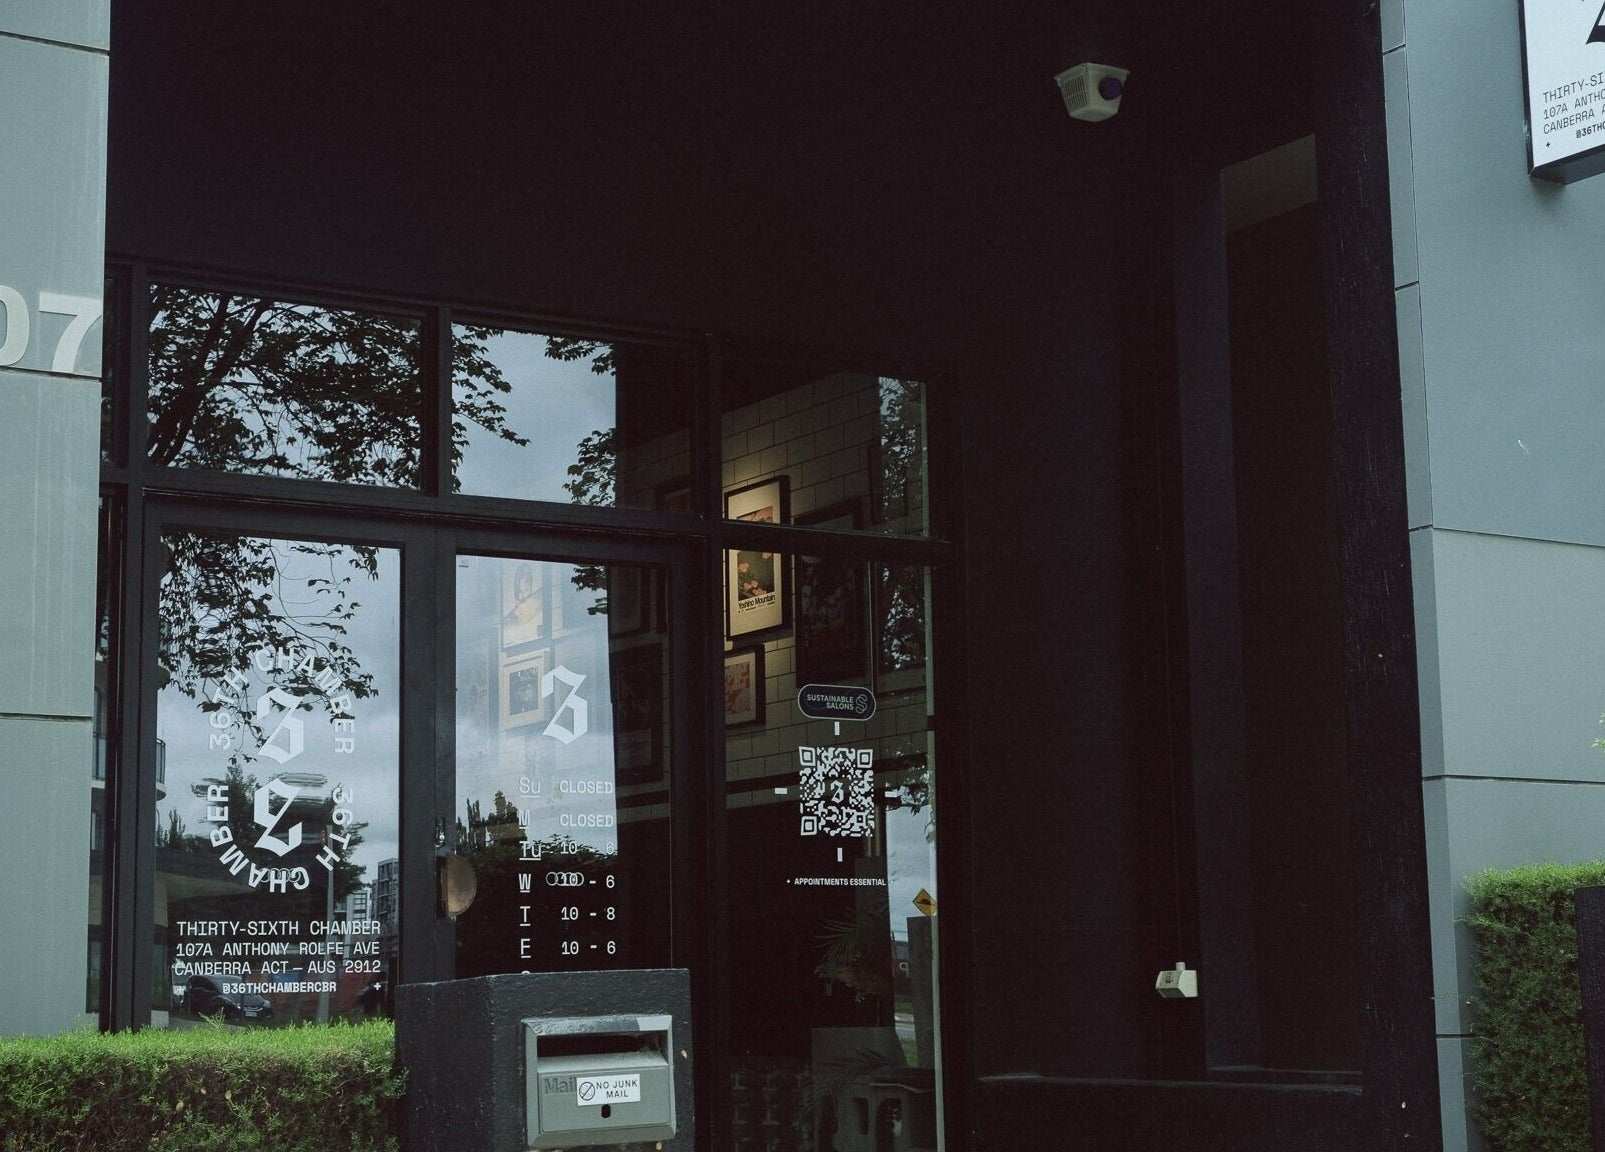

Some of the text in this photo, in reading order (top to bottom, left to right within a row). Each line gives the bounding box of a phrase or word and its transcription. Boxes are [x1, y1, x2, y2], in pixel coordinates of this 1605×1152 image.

[1543, 71, 1605, 103] THIRTY-SI
[1544, 103, 1568, 120] 107A
[1544, 108, 1594, 134] CANBERRA
[208, 645, 356, 754] 36TH CHAMBER
[806, 694, 854, 704] SUSTAINABLE
[826, 702, 854, 710] SALONS
[520, 776, 613, 794] Su CLOSED
[519, 810, 614, 828] M CLOSED
[207, 784, 354, 894] 36TH CHAMBER
[519, 841, 614, 858] Tu 10 6
[519, 874, 532, 890] W
[561, 872, 578, 886] 10
[606, 874, 615, 888] 6
[794, 878, 886, 886] APPOINTMENTS ESSENTIAL
[520, 906, 530, 922] T
[561, 906, 578, 920] 10
[606, 906, 616, 920] 8
[176, 920, 381, 936] THIRTY-SIXTH CHAMBER
[176, 941, 380, 957] 107A ANTHONY ROLFE AVE
[520, 938, 530, 955] F
[562, 941, 579, 955] 10
[607, 940, 616, 954] 6
[174, 961, 252, 976] CANBERRA
[260, 960, 289, 974] ACT
[308, 960, 336, 974] AUS
[345, 960, 381, 974] 2912
[222, 982, 337, 994] @36THCHAMBERCBR
[596, 1080, 638, 1090] NO JUNK
[606, 1090, 629, 1098] MAIL
